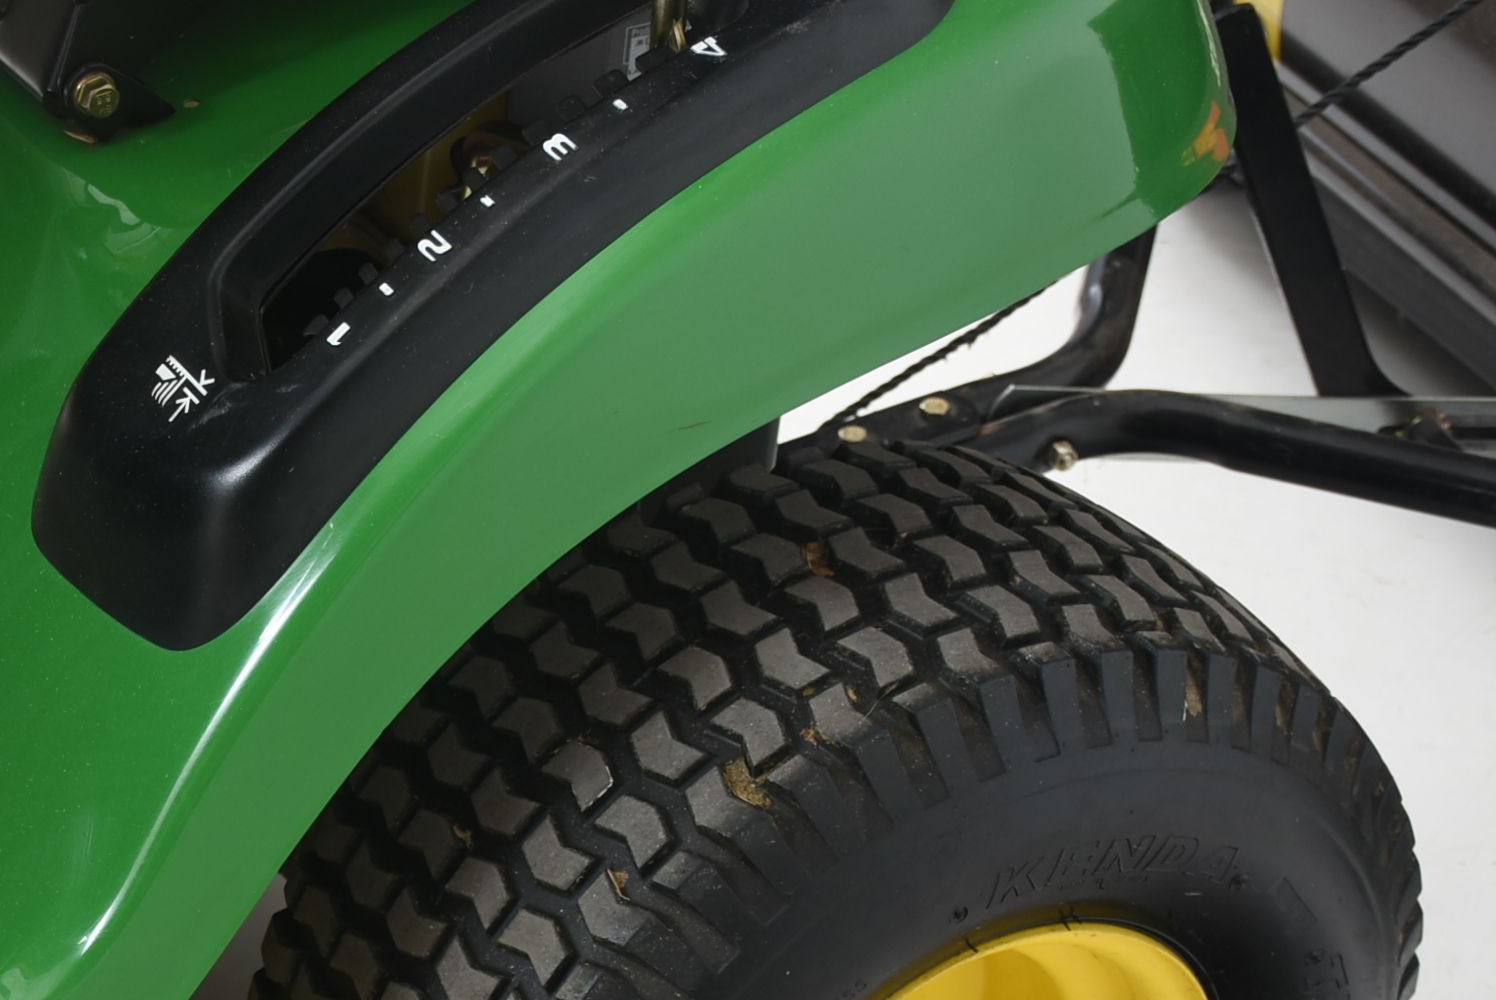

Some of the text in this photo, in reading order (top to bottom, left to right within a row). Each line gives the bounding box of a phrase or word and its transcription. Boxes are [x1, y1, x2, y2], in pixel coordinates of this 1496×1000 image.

[417, 230, 453, 261] 2
[542, 133, 578, 160] 3
[690, 37, 727, 56] 4
[985, 834, 1239, 909] KENDA
